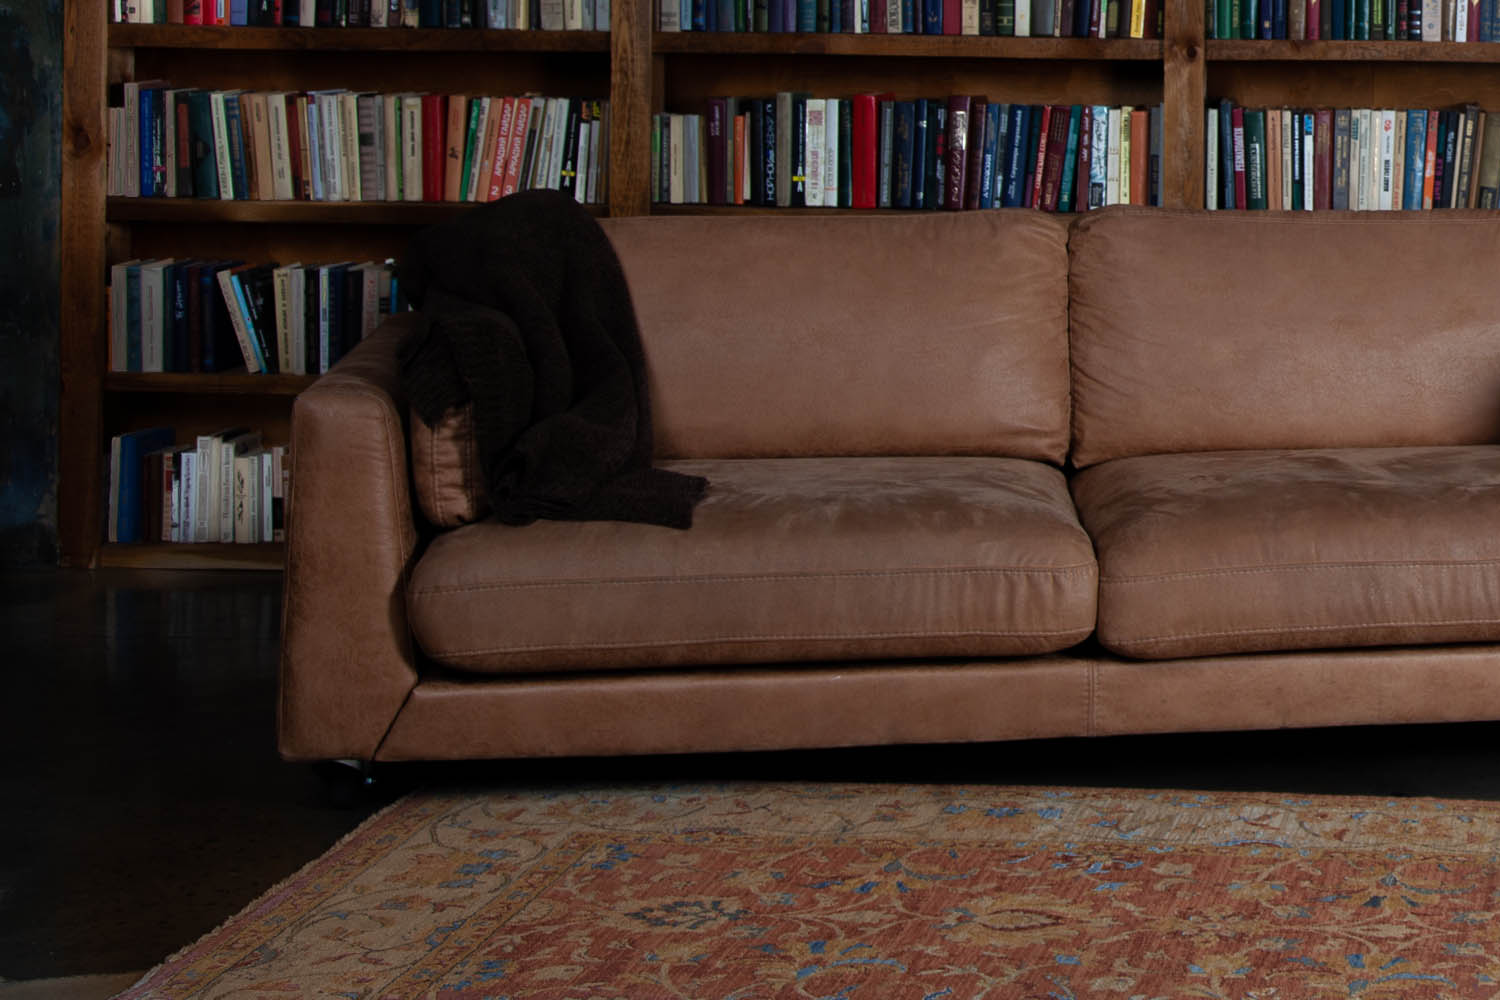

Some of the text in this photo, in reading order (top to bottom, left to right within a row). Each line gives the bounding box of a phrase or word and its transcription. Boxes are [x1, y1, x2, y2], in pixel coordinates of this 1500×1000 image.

[494, 103, 512, 176] АРКАДИЙ ГАЙДАР
[509, 103, 528, 176] АРКАДИЙ ГАЙДАР
[491, 185, 499, 196] 2
[505, 184, 513, 195] 3
